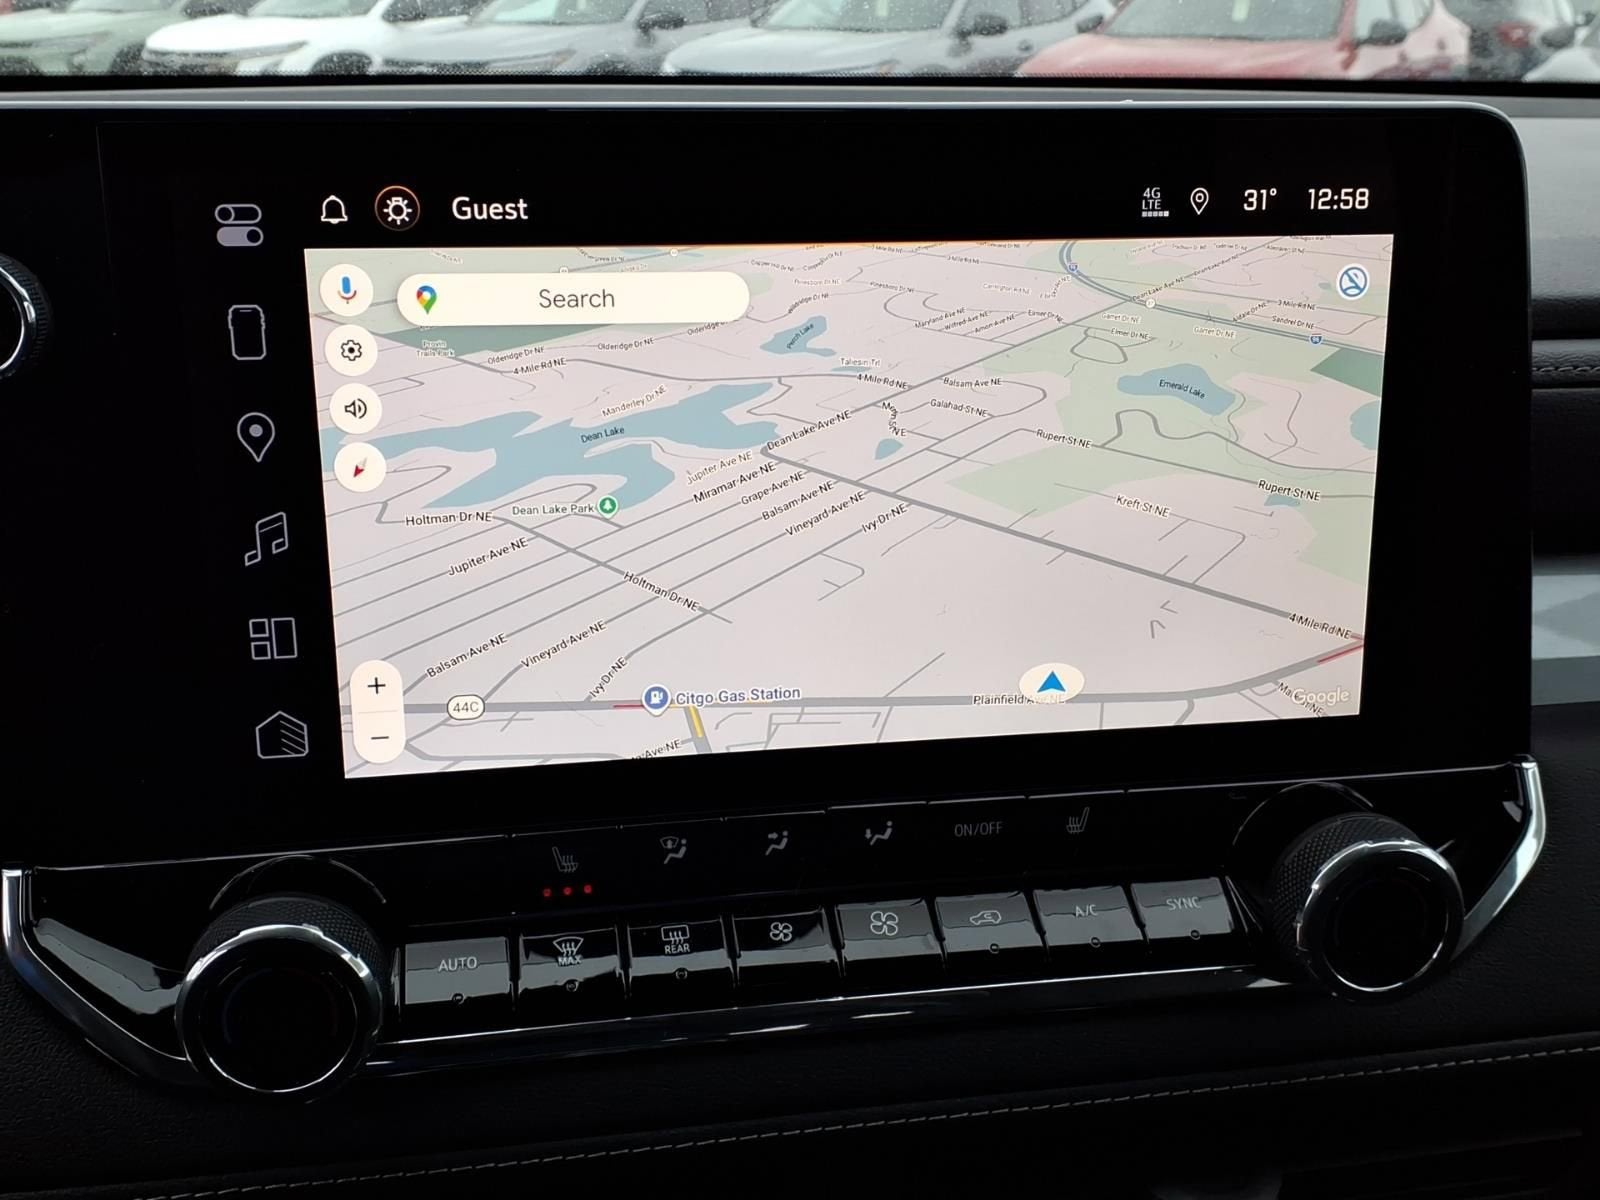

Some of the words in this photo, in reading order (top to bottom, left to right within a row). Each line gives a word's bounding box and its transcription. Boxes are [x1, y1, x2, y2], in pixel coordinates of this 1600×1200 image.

[1143, 187, 1161, 199] 4G
[1307, 187, 1370, 210] 12:58
[452, 196, 529, 220] Guest
[1142, 199, 1161, 211] LTE
[538, 287, 616, 309] Search
[521, 348, 531, 357] Dr
[633, 339, 643, 348] Dr
[643, 336, 654, 345] NE
[513, 366, 519, 375] 4
[519, 361, 540, 374] Mile
[540, 359, 553, 369] Rd
[553, 357, 567, 367] NE
[856, 373, 863, 381] 4
[863, 374, 882, 385] Mile
[883, 377, 895, 387] Rd
[895, 379, 908, 389] NE
[943, 376, 973, 388] Balsam
[974, 378, 989, 387] Ave
[989, 377, 1001, 386] NE
[1159, 379, 1188, 393] Emerald
[1189, 385, 1206, 399] Lake
[602, 397, 645, 417] Manderley
[645, 393, 656, 404] Dr
[655, 385, 668, 397] NE
[930, 397, 964, 412] Galahad
[963, 405, 975, 414] St
[974, 407, 989, 418] NE
[580, 431, 604, 444] Dean
[604, 426, 625, 437] Lake
[767, 435, 792, 451] Dean
[792, 426, 817, 441] Lake
[817, 416, 836, 430] Ave
[835, 409, 853, 424] NE
[1036, 428, 1067, 445] Rupert
[1066, 435, 1077, 445] St
[1077, 437, 1092, 450] NE
[688, 466, 718, 485] Jupiter
[718, 458, 737, 471] Ave
[738, 450, 753, 463] NE
[693, 480, 738, 504] Miramar
[738, 470, 760, 485] Ave
[759, 460, 777, 476] NE
[741, 487, 770, 506] Grape
[770, 479, 790, 493] Ave
[789, 470, 806, 484] NE
[1258, 478, 1293, 497] Rupert
[1293, 485, 1304, 498] St
[1304, 489, 1321, 502] NE
[512, 505, 539, 516] Dean
[542, 504, 568, 515] Lake
[570, 503, 595, 514] Park
[762, 499, 799, 521] Balsam
[799, 490, 820, 504] Ave
[819, 480, 835, 495] NE
[1115, 494, 1143, 512] Kreft
[1142, 500, 1153, 513] St
[1152, 504, 1170, 518] NE
[406, 512, 458, 527] Holtman
[458, 512, 472, 522] Dr
[475, 511, 493, 522] NE
[785, 510, 830, 536] Vineyard
[829, 500, 850, 515] Ave
[849, 491, 865, 505] NE
[862, 518, 878, 535] Ivy
[877, 511, 892, 525] Dr
[891, 502, 908, 518] NE
[448, 555, 488, 576] Jupiter
[489, 545, 510, 560] Ave
[510, 537, 528, 552] NE
[624, 571, 668, 598] Holtman
[668, 591, 683, 603] Dr
[682, 598, 700, 612] NE
[1289, 612, 1297, 623] 4
[1297, 614, 1321, 629] Mile
[1320, 621, 1335, 636] Rd
[1335, 627, 1352, 640] NE
[521, 639, 569, 669] Vineyard
[568, 628, 590, 647] Ave
[589, 619, 607, 635] NE
[427, 652, 468, 680] Balsam
[468, 641, 491, 660] Ave
[489, 632, 508, 648] NE
[590, 681, 606, 699] Ivy
[601, 670, 616, 686] Dr
[611, 657, 628, 674] NE
[676, 691, 714, 707] Citgo
[718, 690, 745, 703] Gas
[749, 687, 801, 702] Station
[973, 694, 1025, 705] Plainfield
[1291, 686, 1350, 707] Google
[452, 700, 480, 715] 44C
[1308, 702, 1324, 718] NE
[645, 747, 664, 759] Ave
[665, 738, 683, 752] NE
[954, 821, 1003, 838] ON/OFF
[1075, 904, 1098, 919] A/C
[1166, 896, 1200, 911] SYNC
[664, 942, 690, 954] REAR
[439, 956, 478, 971] AUTO
[557, 954, 582, 967] MAX
